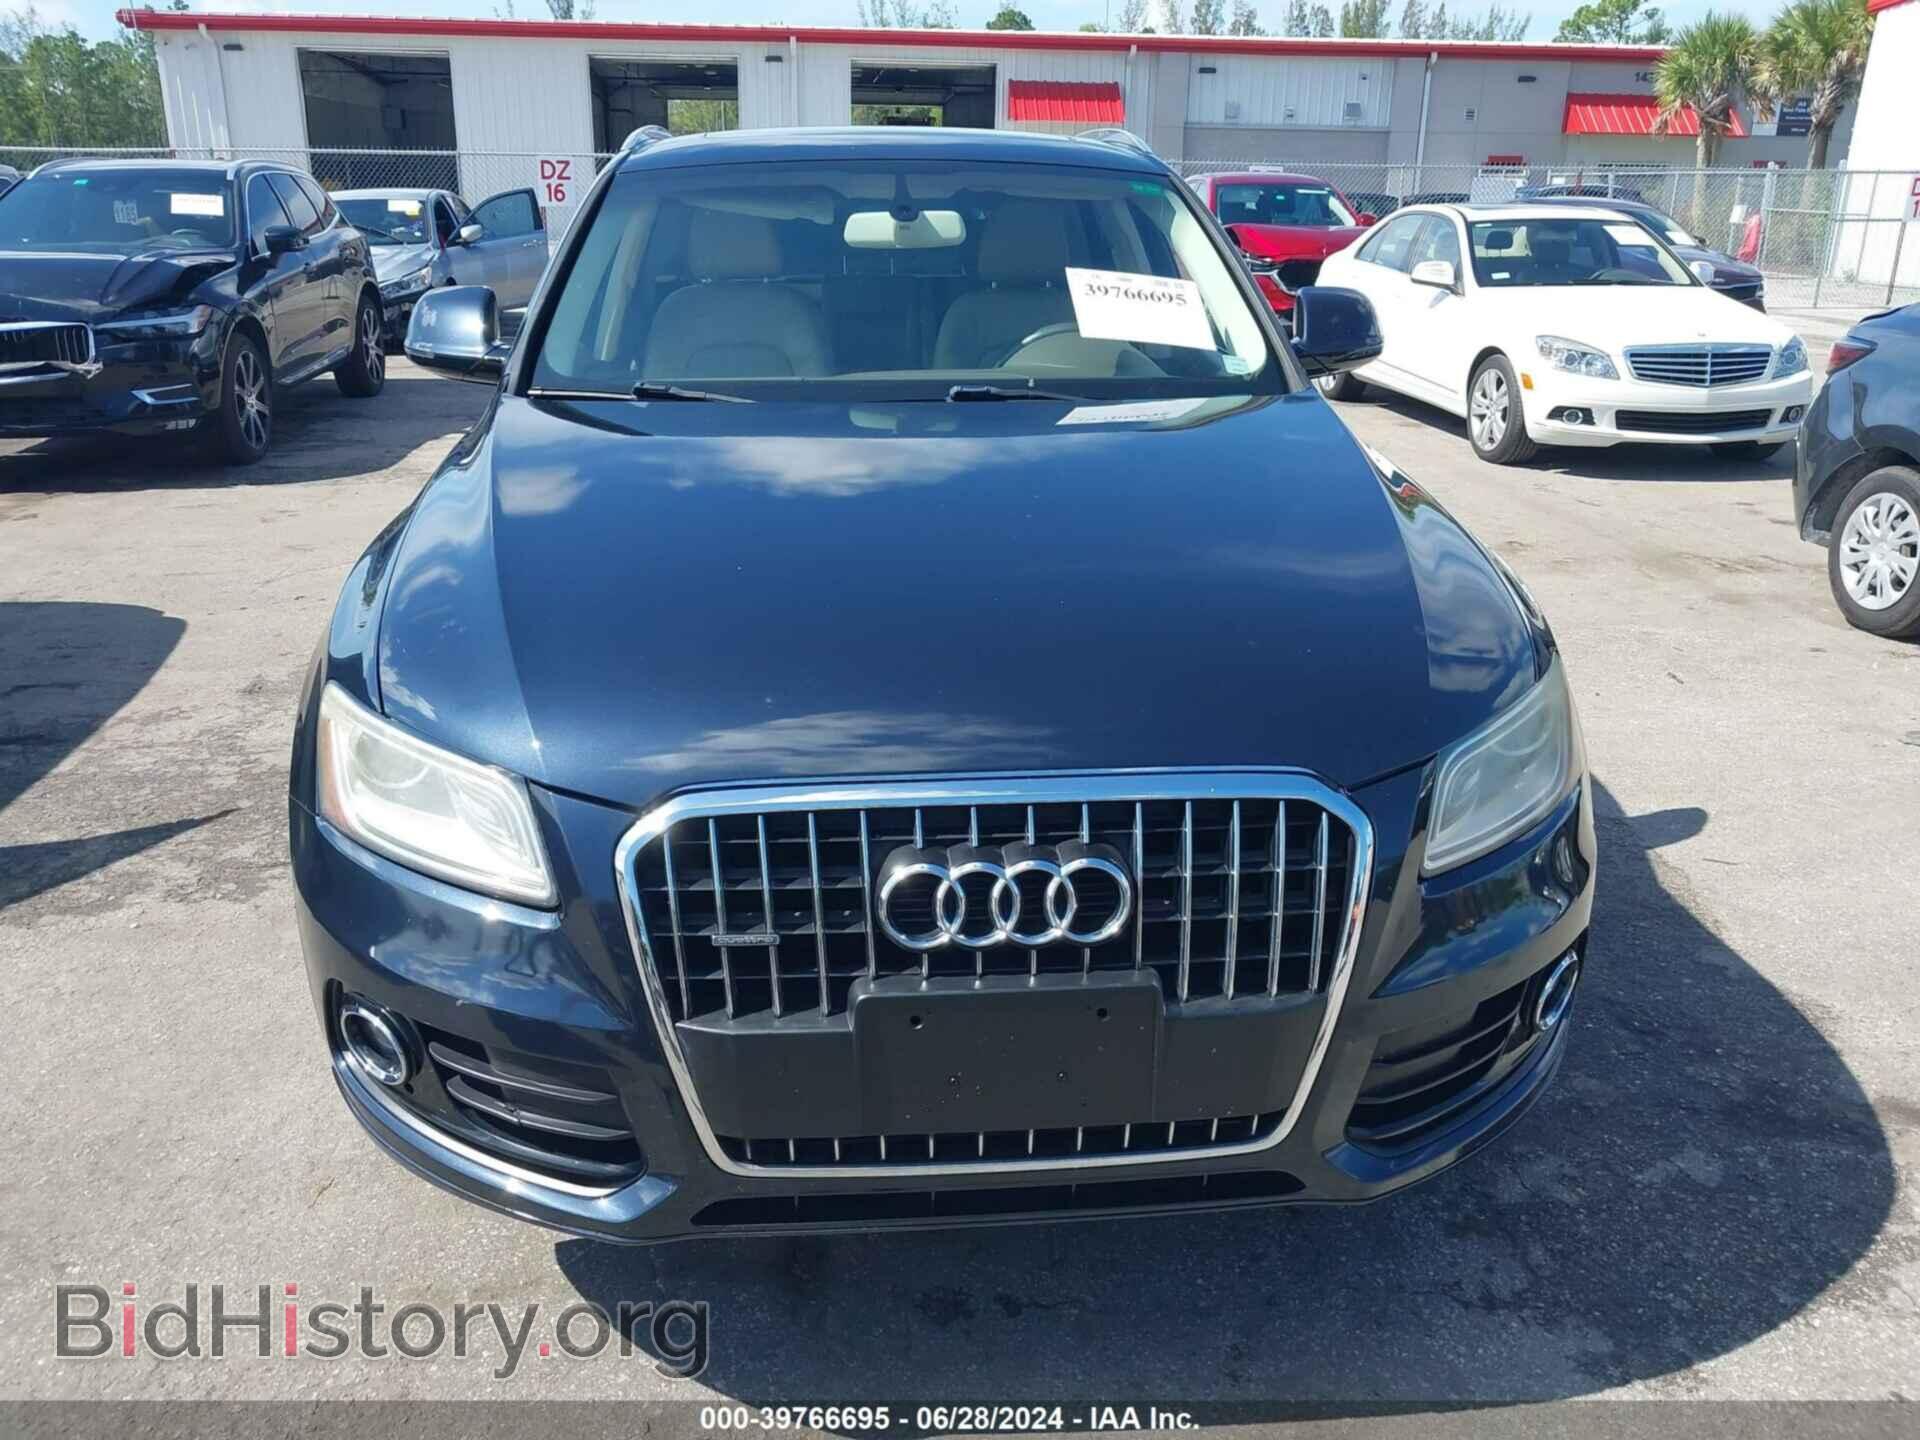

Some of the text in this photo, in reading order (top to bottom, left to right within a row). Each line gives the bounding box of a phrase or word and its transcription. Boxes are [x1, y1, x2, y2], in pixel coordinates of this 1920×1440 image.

[540, 160, 571, 180] DZ
[546, 183, 566, 202] 16
[1084, 283, 1188, 306] 39766695
